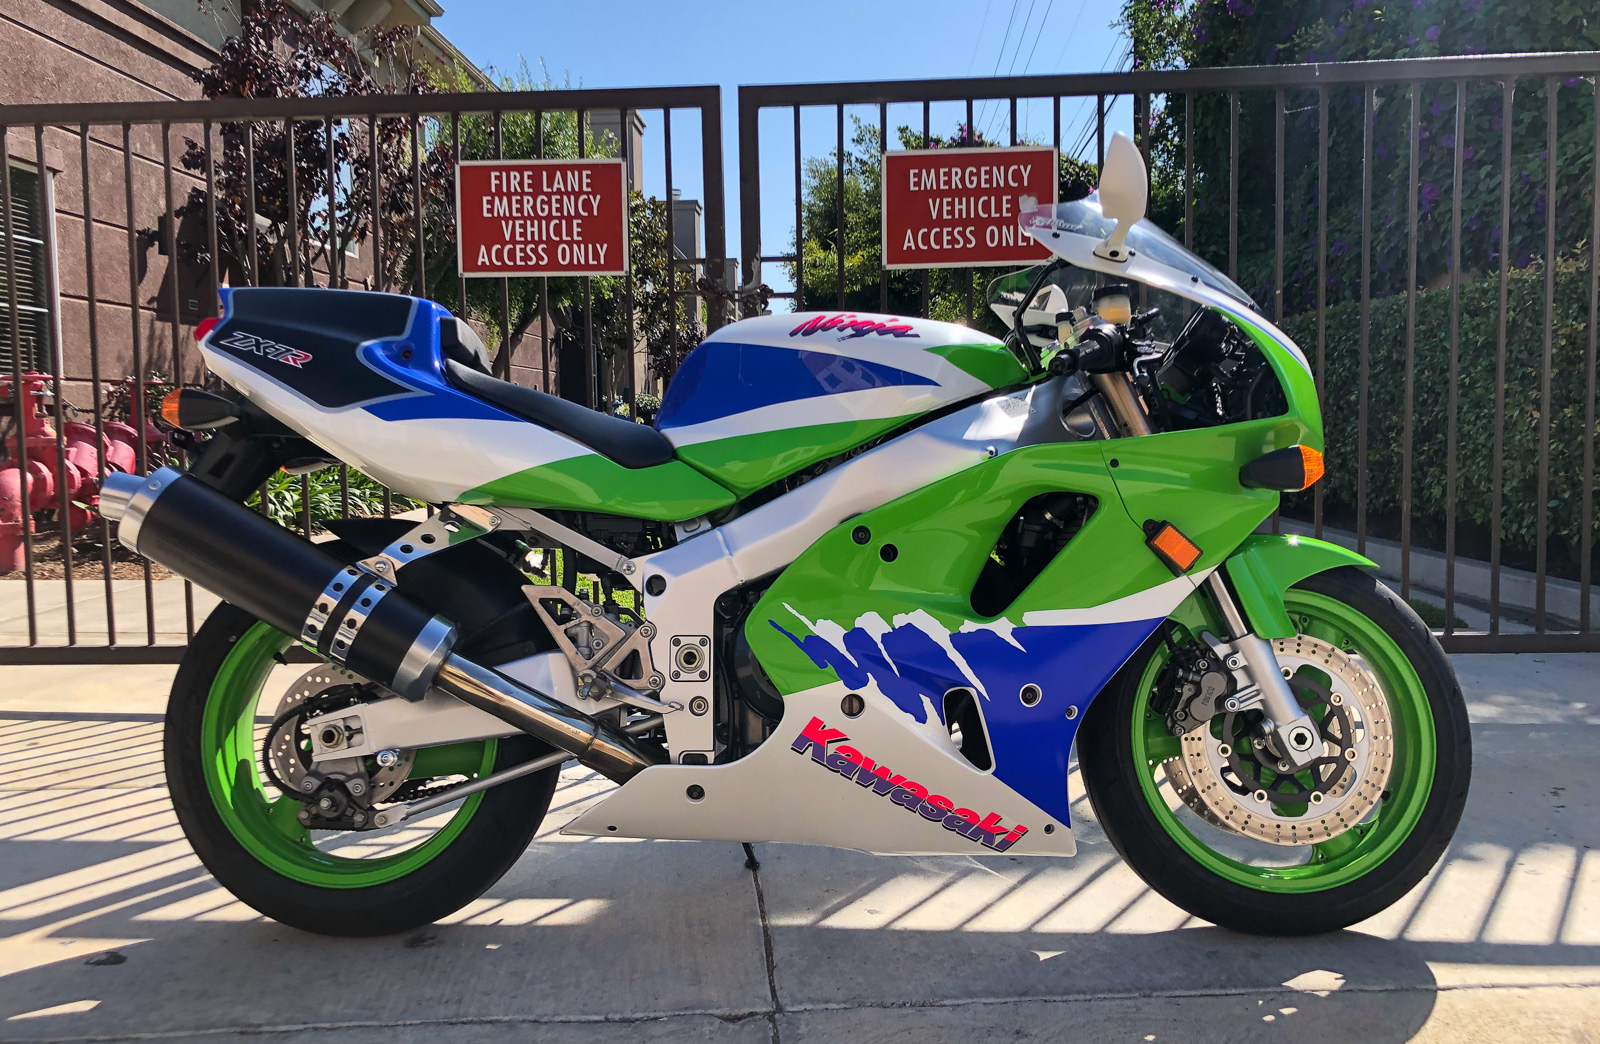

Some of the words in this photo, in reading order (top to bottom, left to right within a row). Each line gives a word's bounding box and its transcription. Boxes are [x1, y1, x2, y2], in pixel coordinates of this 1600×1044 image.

[490, 171, 533, 193] FIRE
[542, 170, 592, 192] LANE
[908, 164, 1032, 191] EMERGENCY
[482, 194, 601, 217] EMERGENCY
[928, 195, 1012, 220] VEHICLE
[501, 219, 583, 241] VEHICLE
[903, 226, 976, 251] ACCESS
[477, 244, 549, 266] ACCESS
[557, 243, 608, 265] ONLY
[788, 313, 921, 343] Ninja
[790, 715, 1029, 853] Kawasaki
